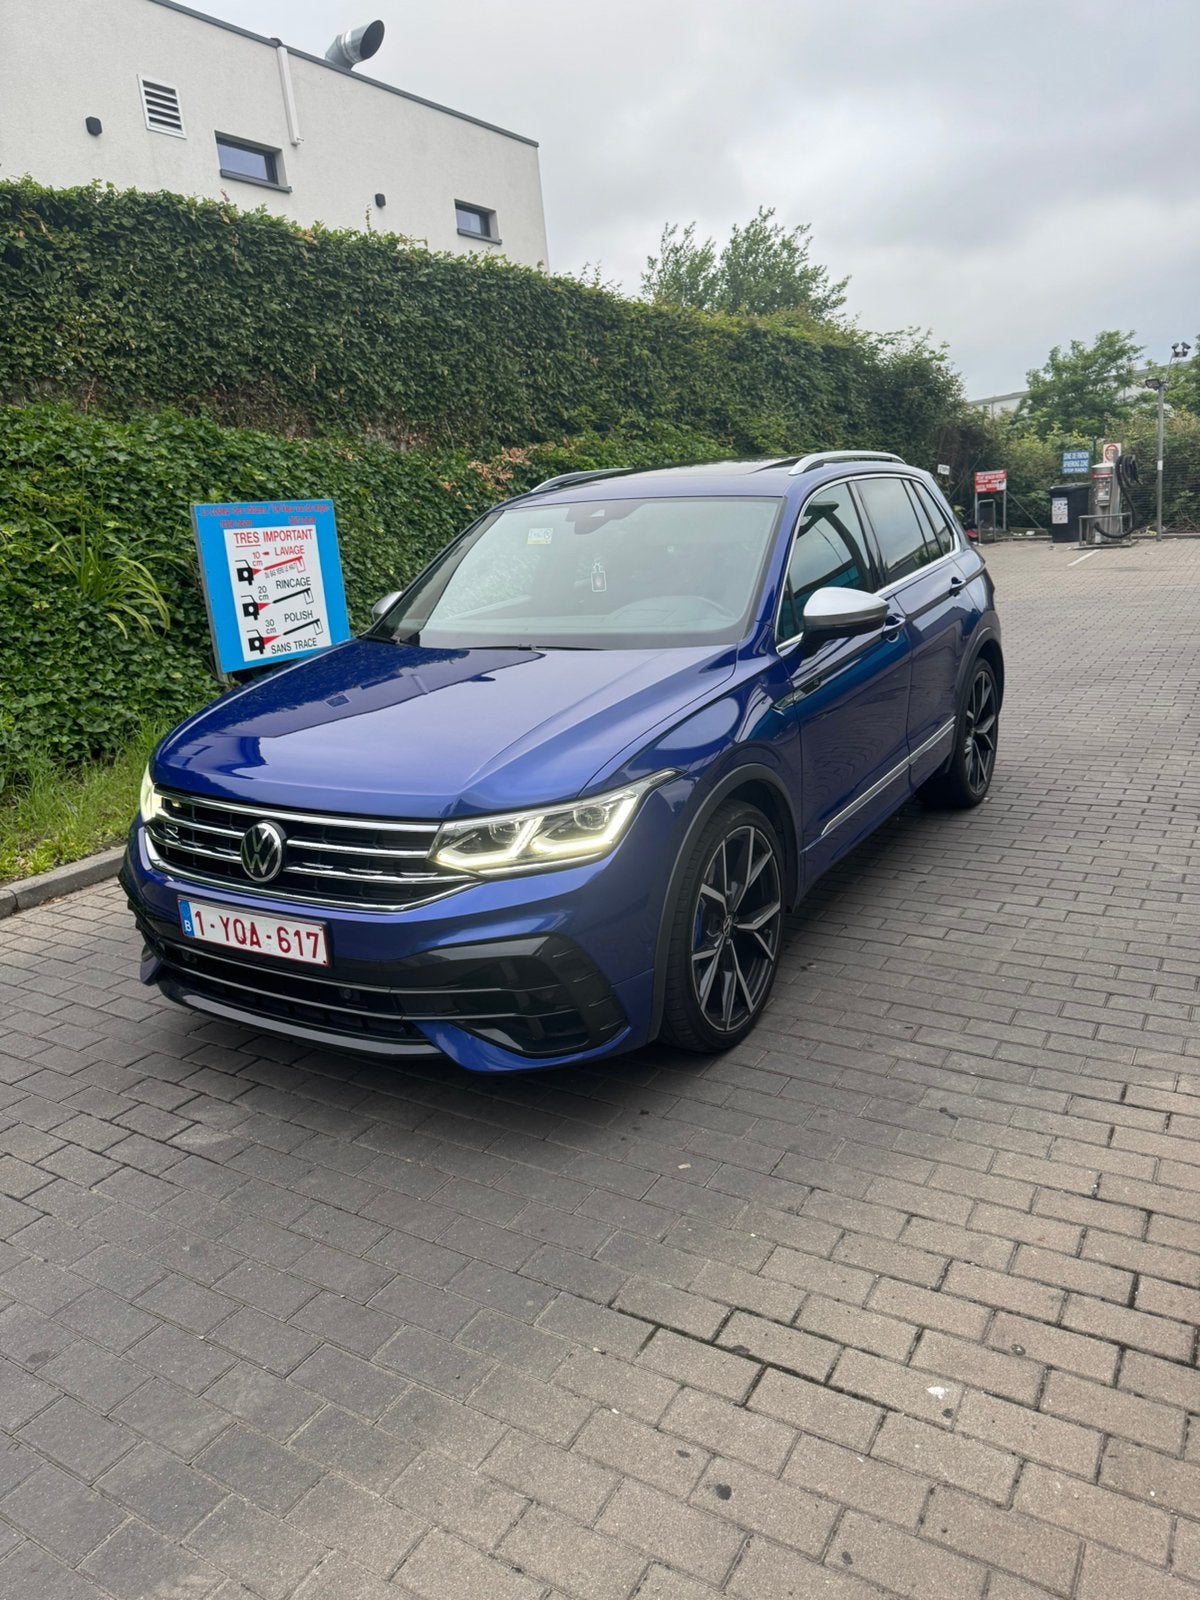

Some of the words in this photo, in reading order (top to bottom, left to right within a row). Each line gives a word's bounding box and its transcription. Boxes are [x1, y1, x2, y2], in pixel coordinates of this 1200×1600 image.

[233, 531, 260, 544] TRES
[263, 529, 312, 542] IMPORTANT
[252, 551, 261, 559] 10
[274, 545, 305, 556] LAVAGE
[257, 586, 267, 594] 20
[275, 577, 311, 589] RINCAGE
[265, 619, 275, 627] 30
[284, 610, 313, 622] POLISH
[271, 642, 292, 654] SANS
[294, 638, 318, 650] TRACE
[184, 919, 192, 932] B
[195, 910, 319, 959] 1-YQA-617
